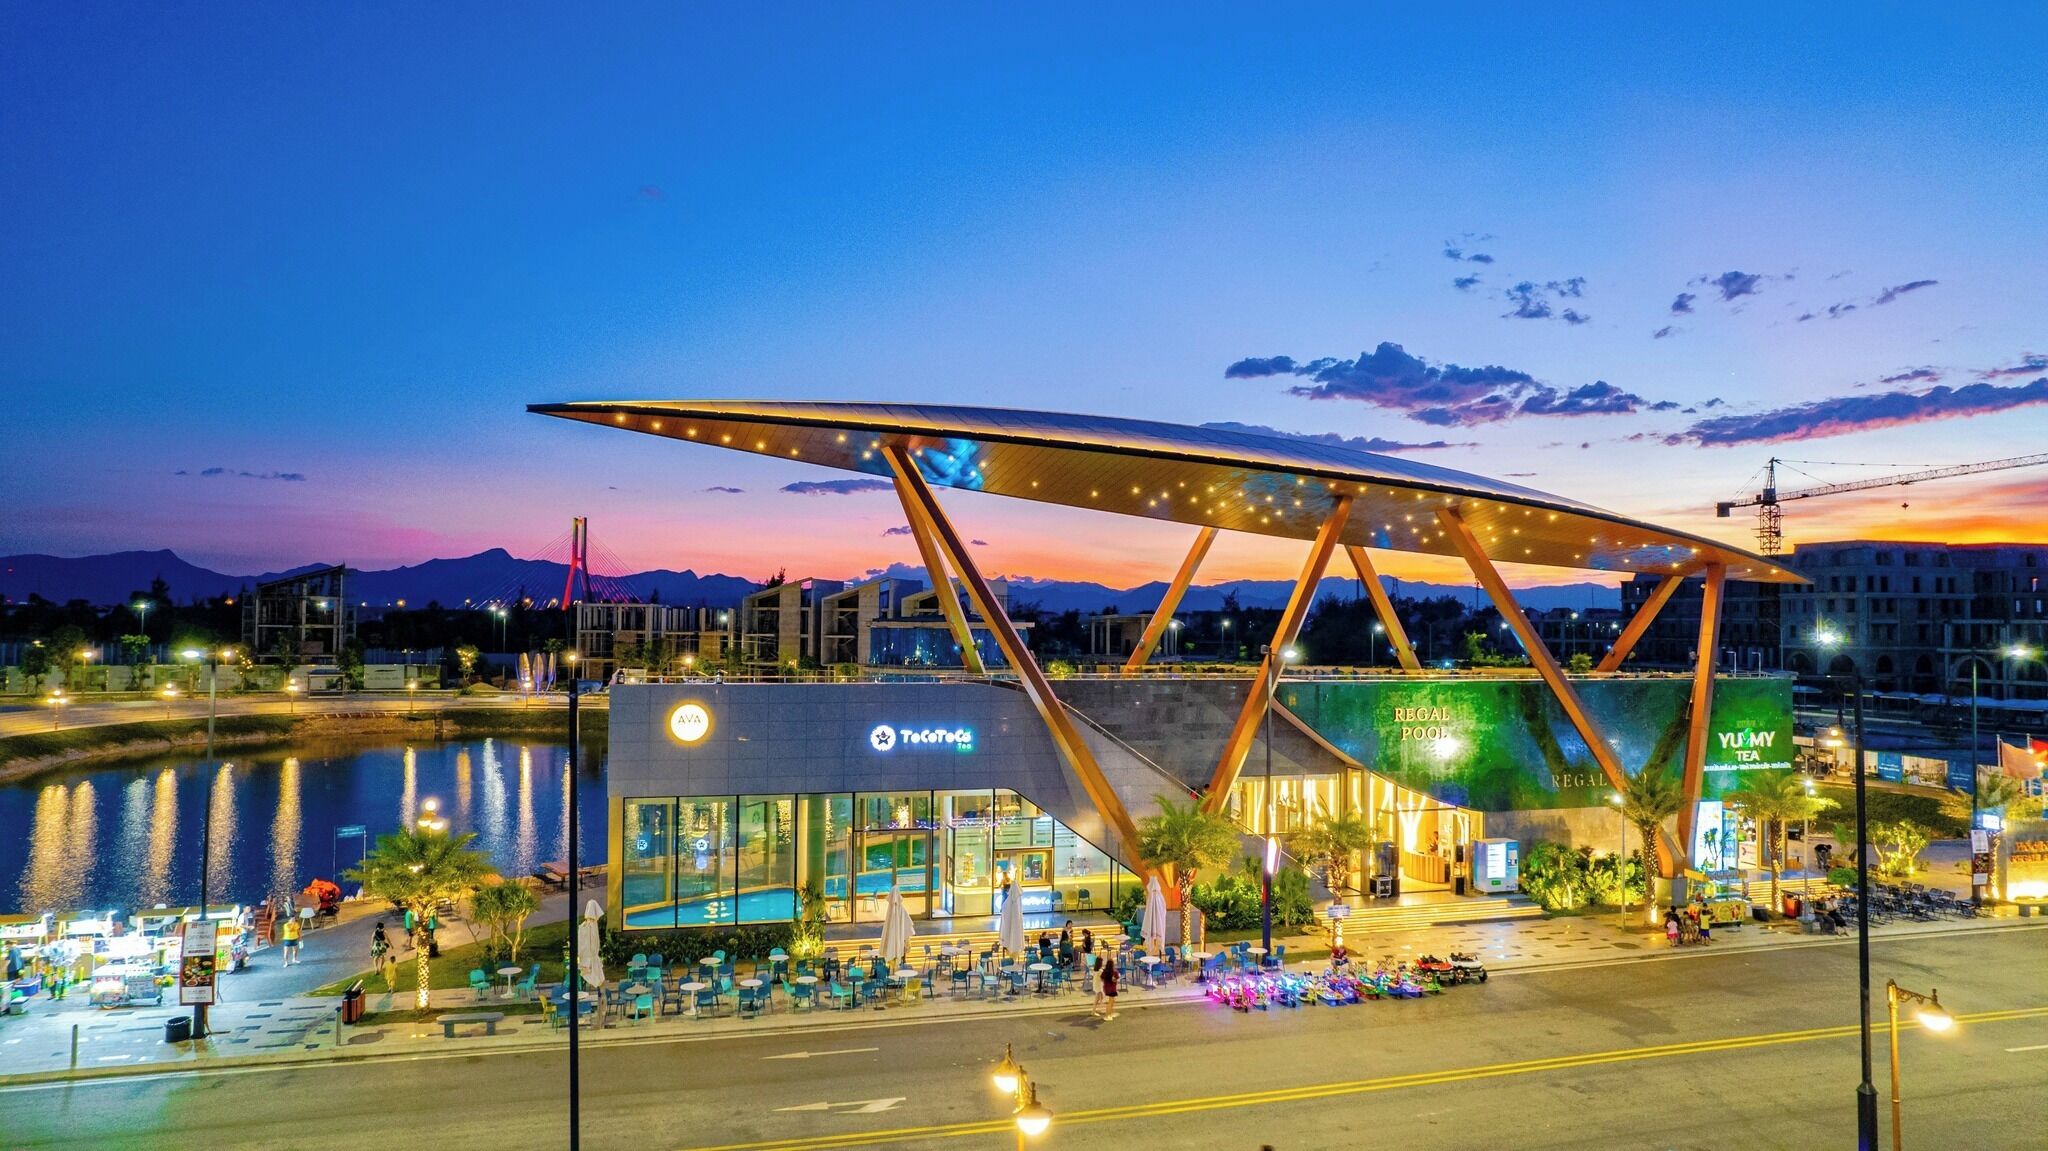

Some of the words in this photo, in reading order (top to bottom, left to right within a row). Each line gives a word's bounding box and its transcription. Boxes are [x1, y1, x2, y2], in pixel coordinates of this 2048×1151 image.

[678, 714, 702, 724] AVA
[1394, 706, 1450, 721] REGAL
[1401, 726, 1448, 741] POOL
[1735, 750, 1760, 762] TEA
[1551, 772, 1608, 788] REGAL
